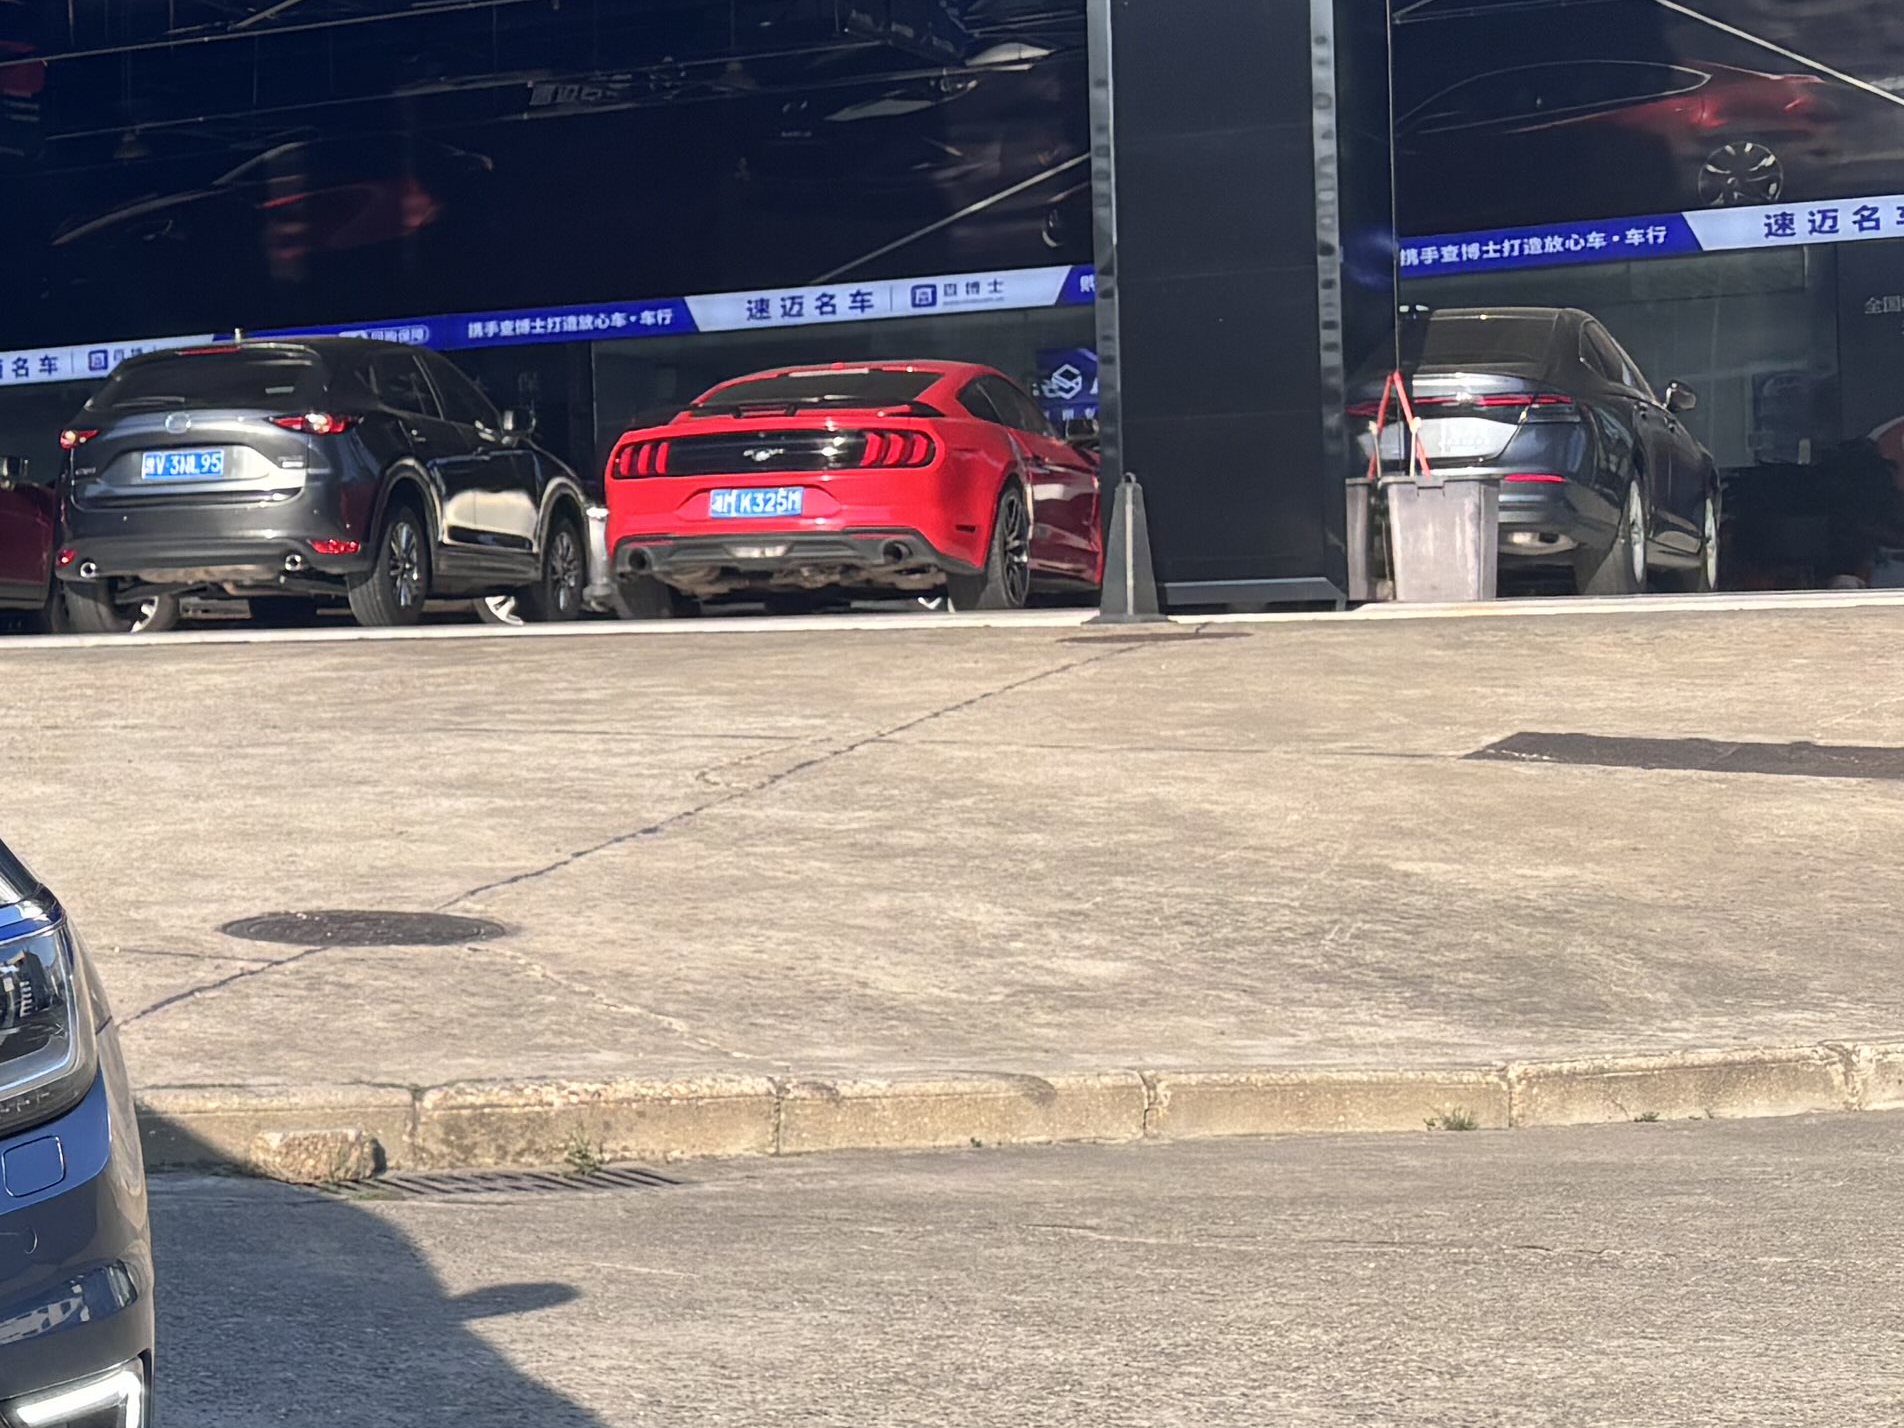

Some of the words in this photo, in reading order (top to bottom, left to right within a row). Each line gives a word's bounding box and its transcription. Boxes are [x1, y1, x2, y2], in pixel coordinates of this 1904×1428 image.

[1763, 207, 1904, 240] 速迈名
[745, 289, 874, 322] 速迈名车
[1863, 295, 1904, 315] 全国
